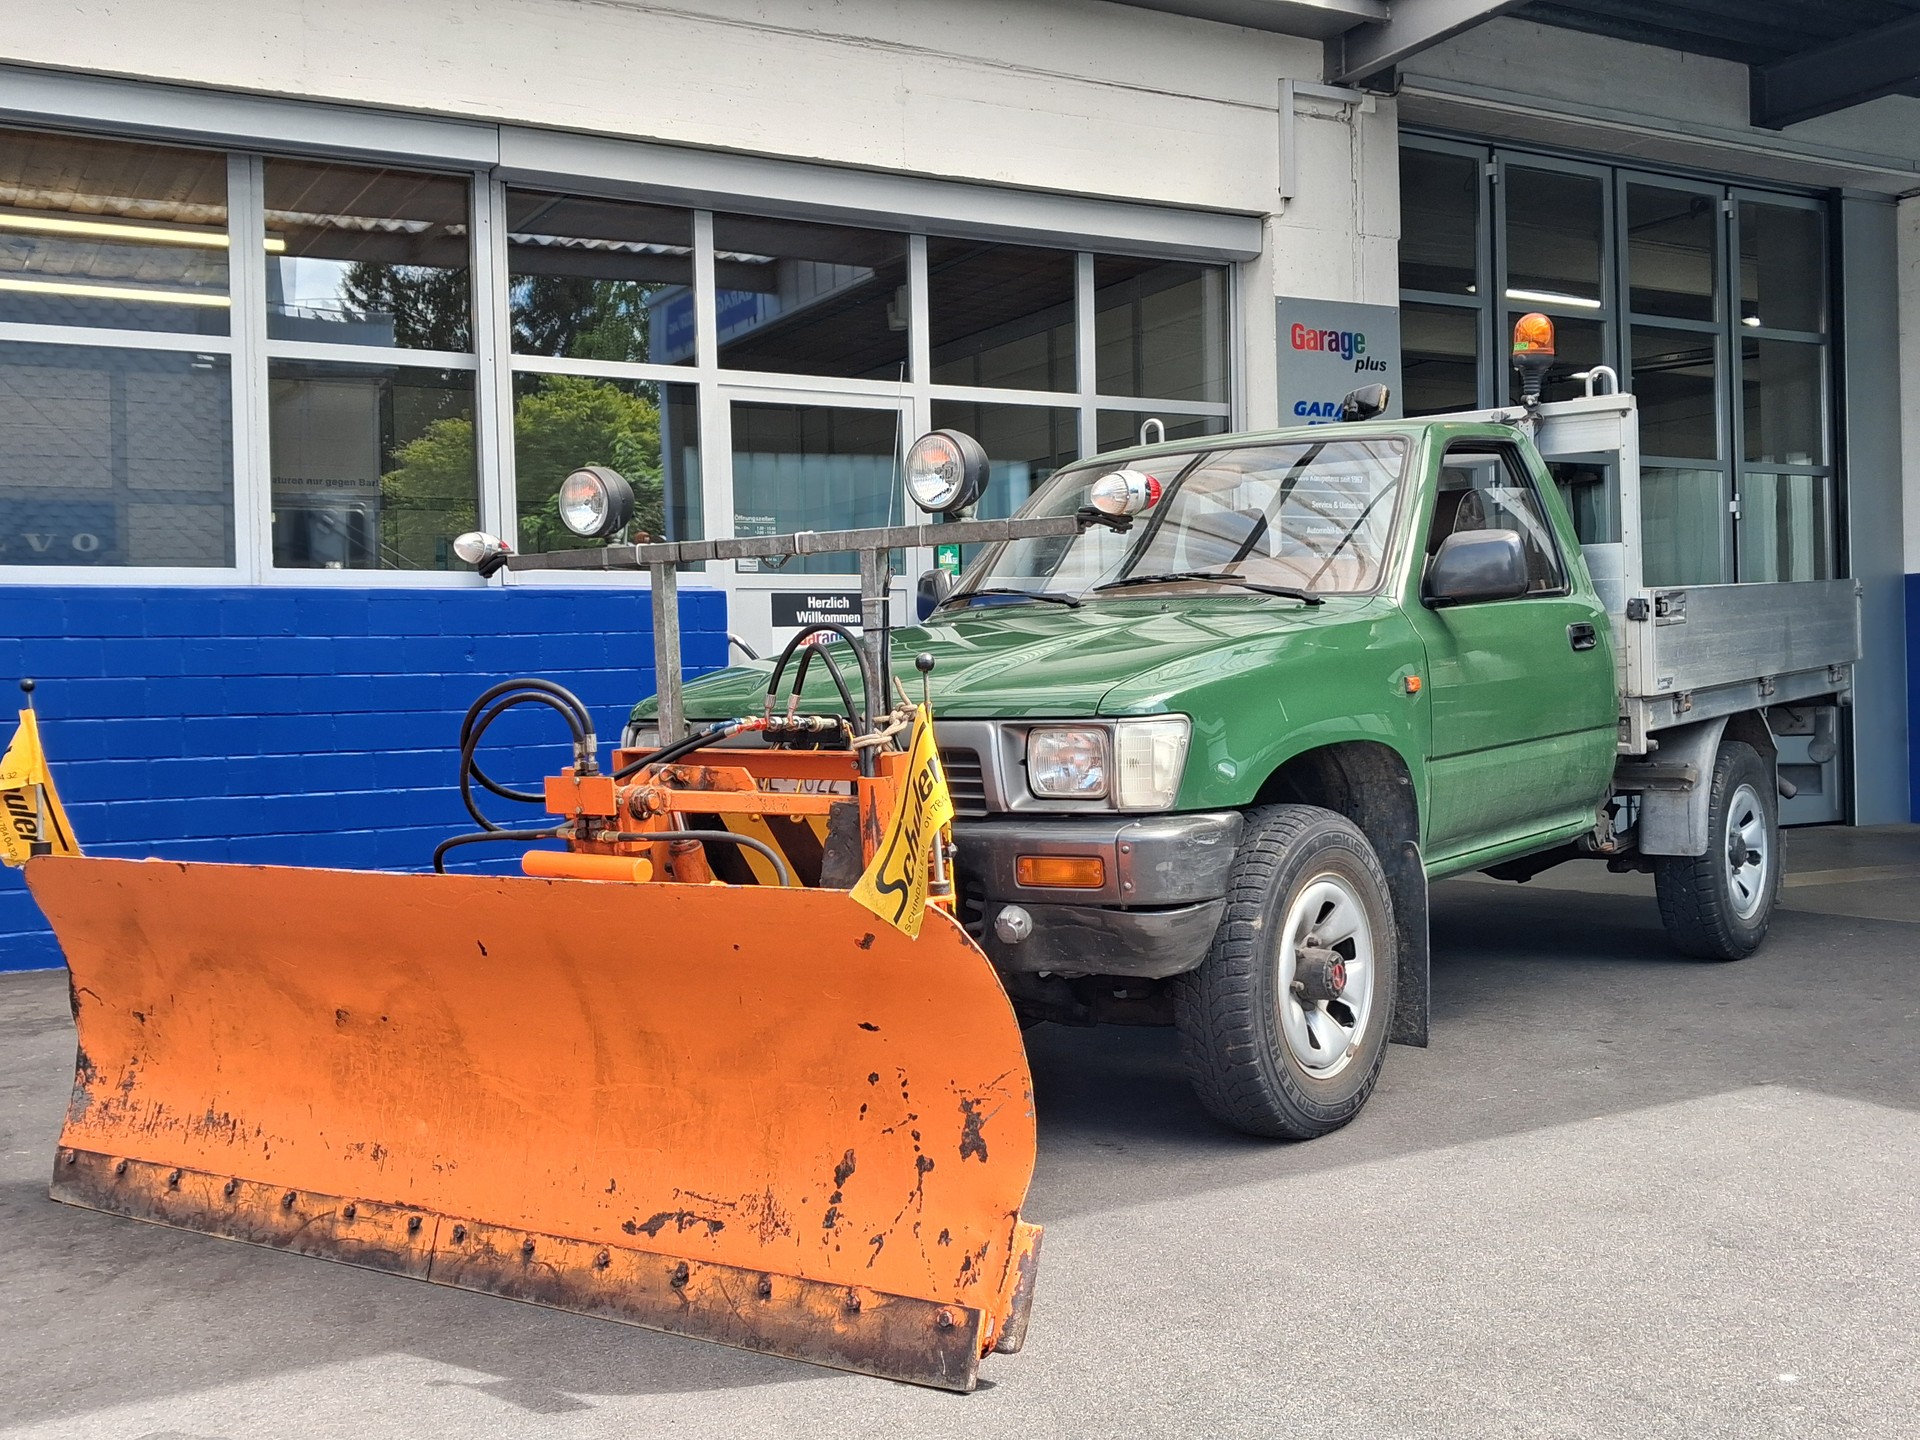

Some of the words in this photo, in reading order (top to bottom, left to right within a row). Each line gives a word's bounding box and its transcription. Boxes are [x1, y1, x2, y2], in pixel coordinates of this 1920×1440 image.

[1291, 322, 1366, 361] Garage
[1355, 356, 1387, 373] plus
[807, 596, 850, 609] Herzlich
[796, 610, 861, 624] Willkommen
[876, 721, 943, 925] Schuler
[904, 843, 926, 933] SCHINDELLEGI
